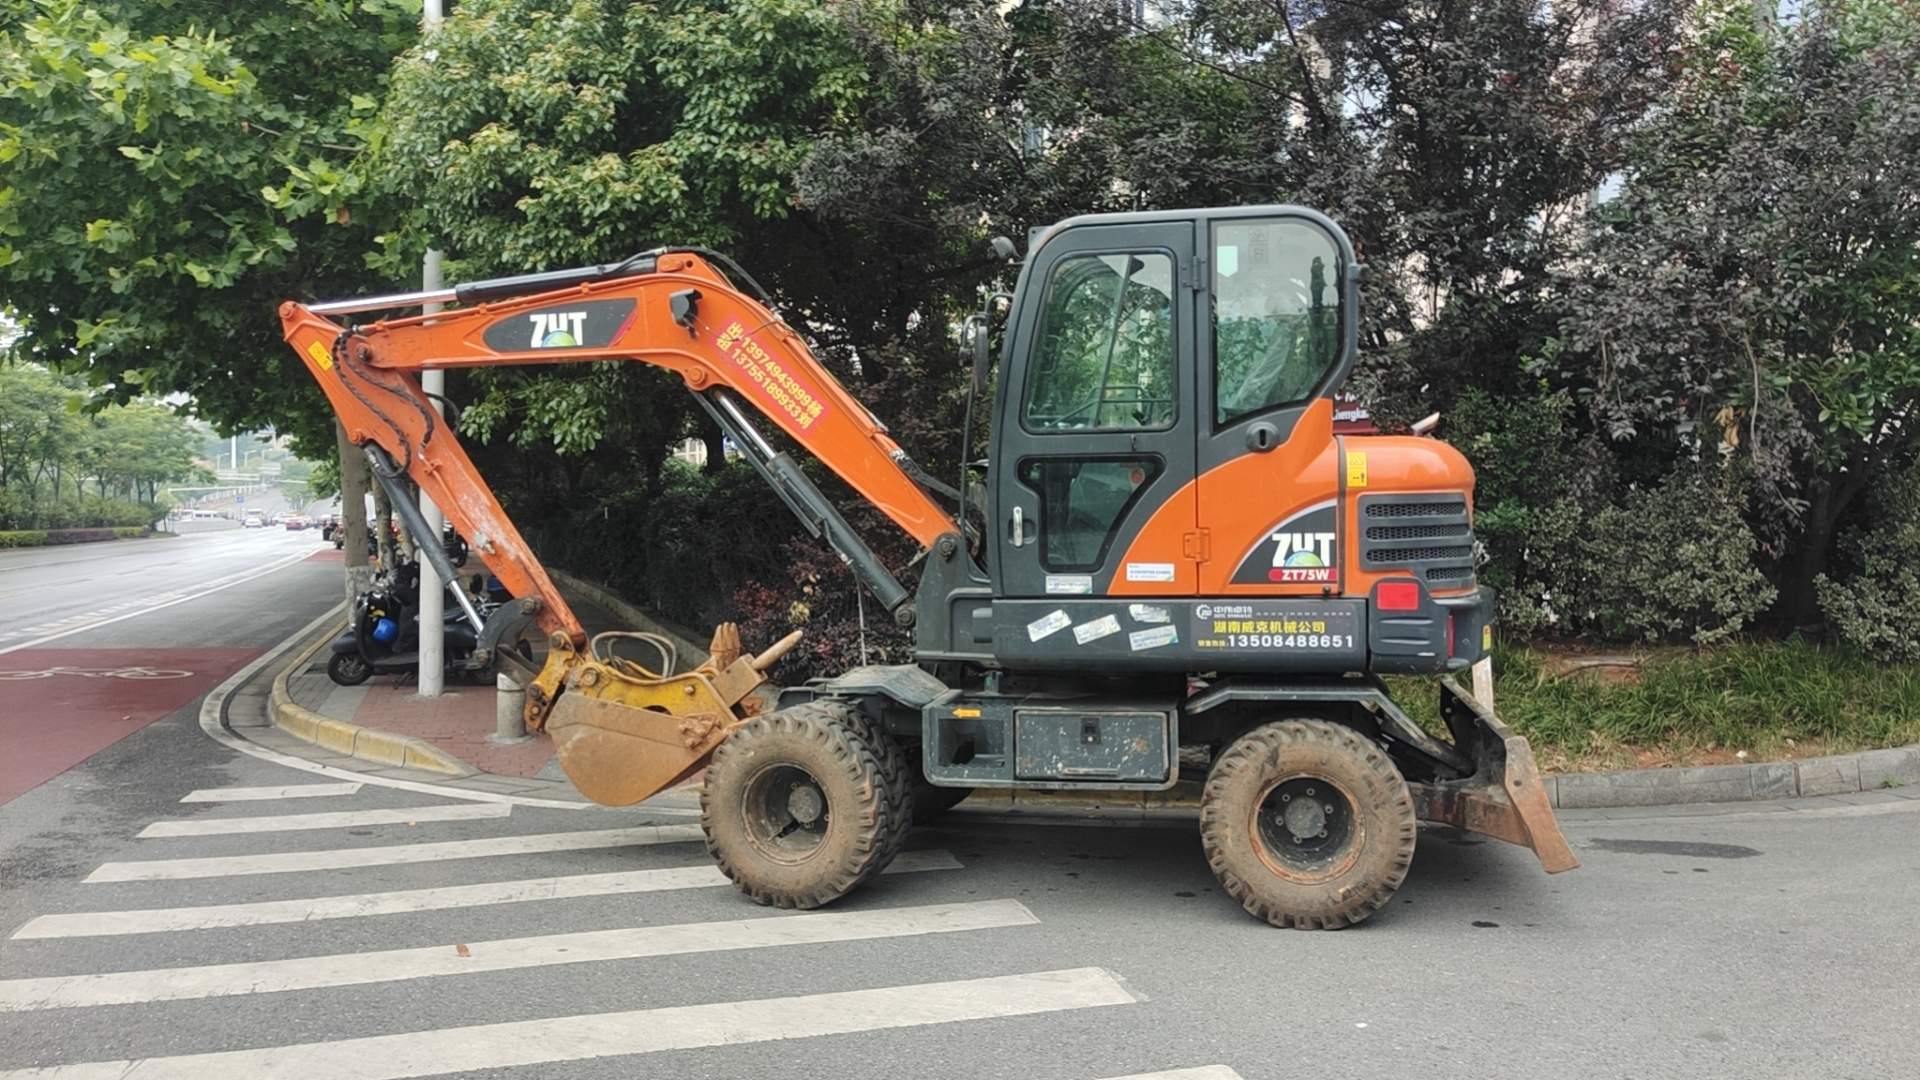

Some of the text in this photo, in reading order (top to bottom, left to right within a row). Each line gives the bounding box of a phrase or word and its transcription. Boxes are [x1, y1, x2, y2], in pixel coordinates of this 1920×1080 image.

[529, 311, 587, 348] ZUT
[1271, 533, 1336, 567] ZUT
[1281, 569, 1330, 581] ZT75W
[1213, 620, 1326, 634] 湖南威克机械公司
[1228, 634, 1354, 648] 13508488651
